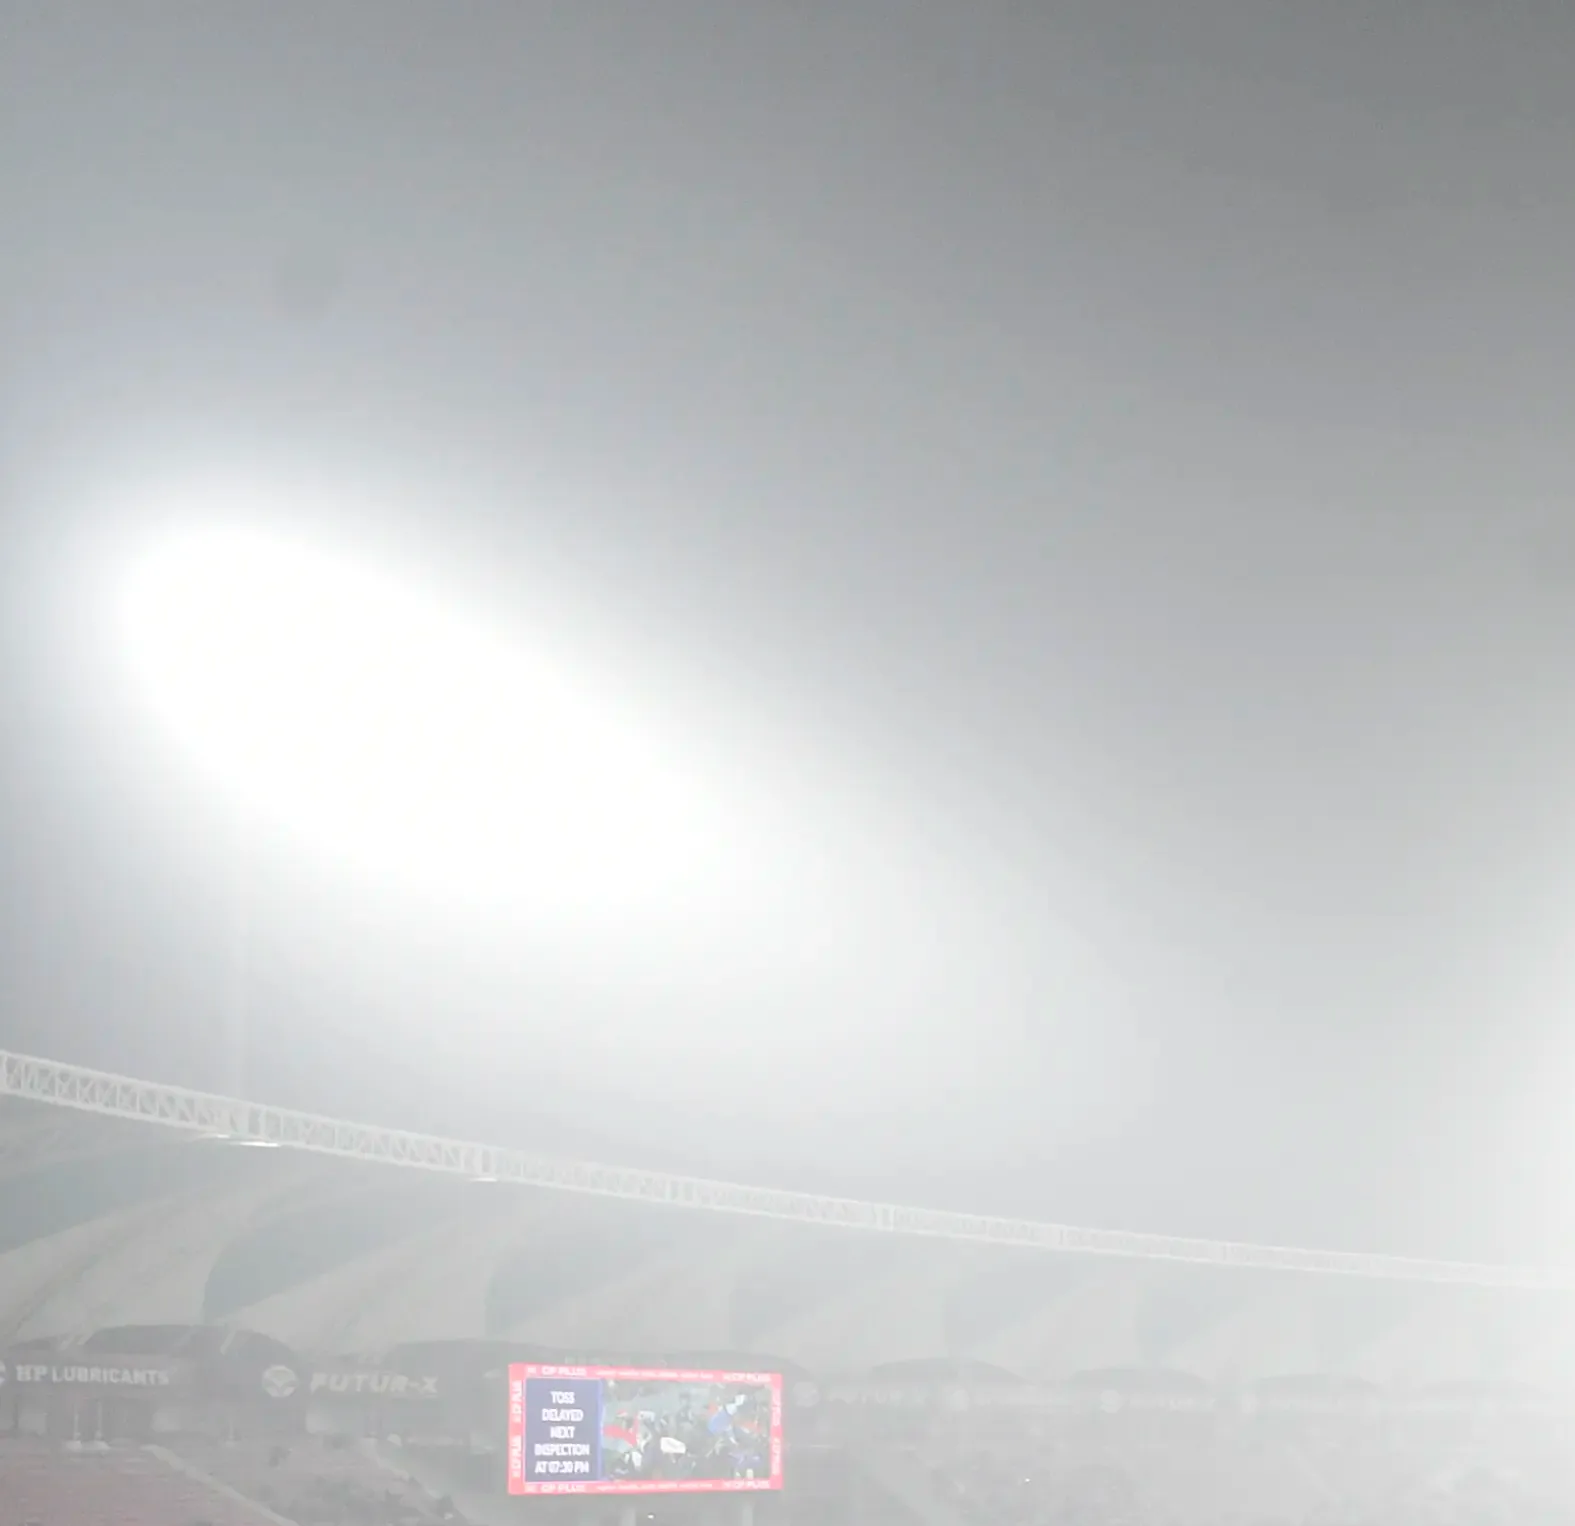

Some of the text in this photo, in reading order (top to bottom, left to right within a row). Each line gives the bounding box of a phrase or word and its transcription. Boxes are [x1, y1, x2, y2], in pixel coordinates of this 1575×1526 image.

[52, 1366, 169, 1386] LUBRICANTS
[549, 1390, 576, 1405] TOSS
[541, 1407, 584, 1422] DELAYED
[549, 1425, 576, 1440] NEXT
[534, 1442, 590, 1456] INSPECTION
[534, 1460, 547, 1475] AT
[574, 1461, 590, 1475] PM
